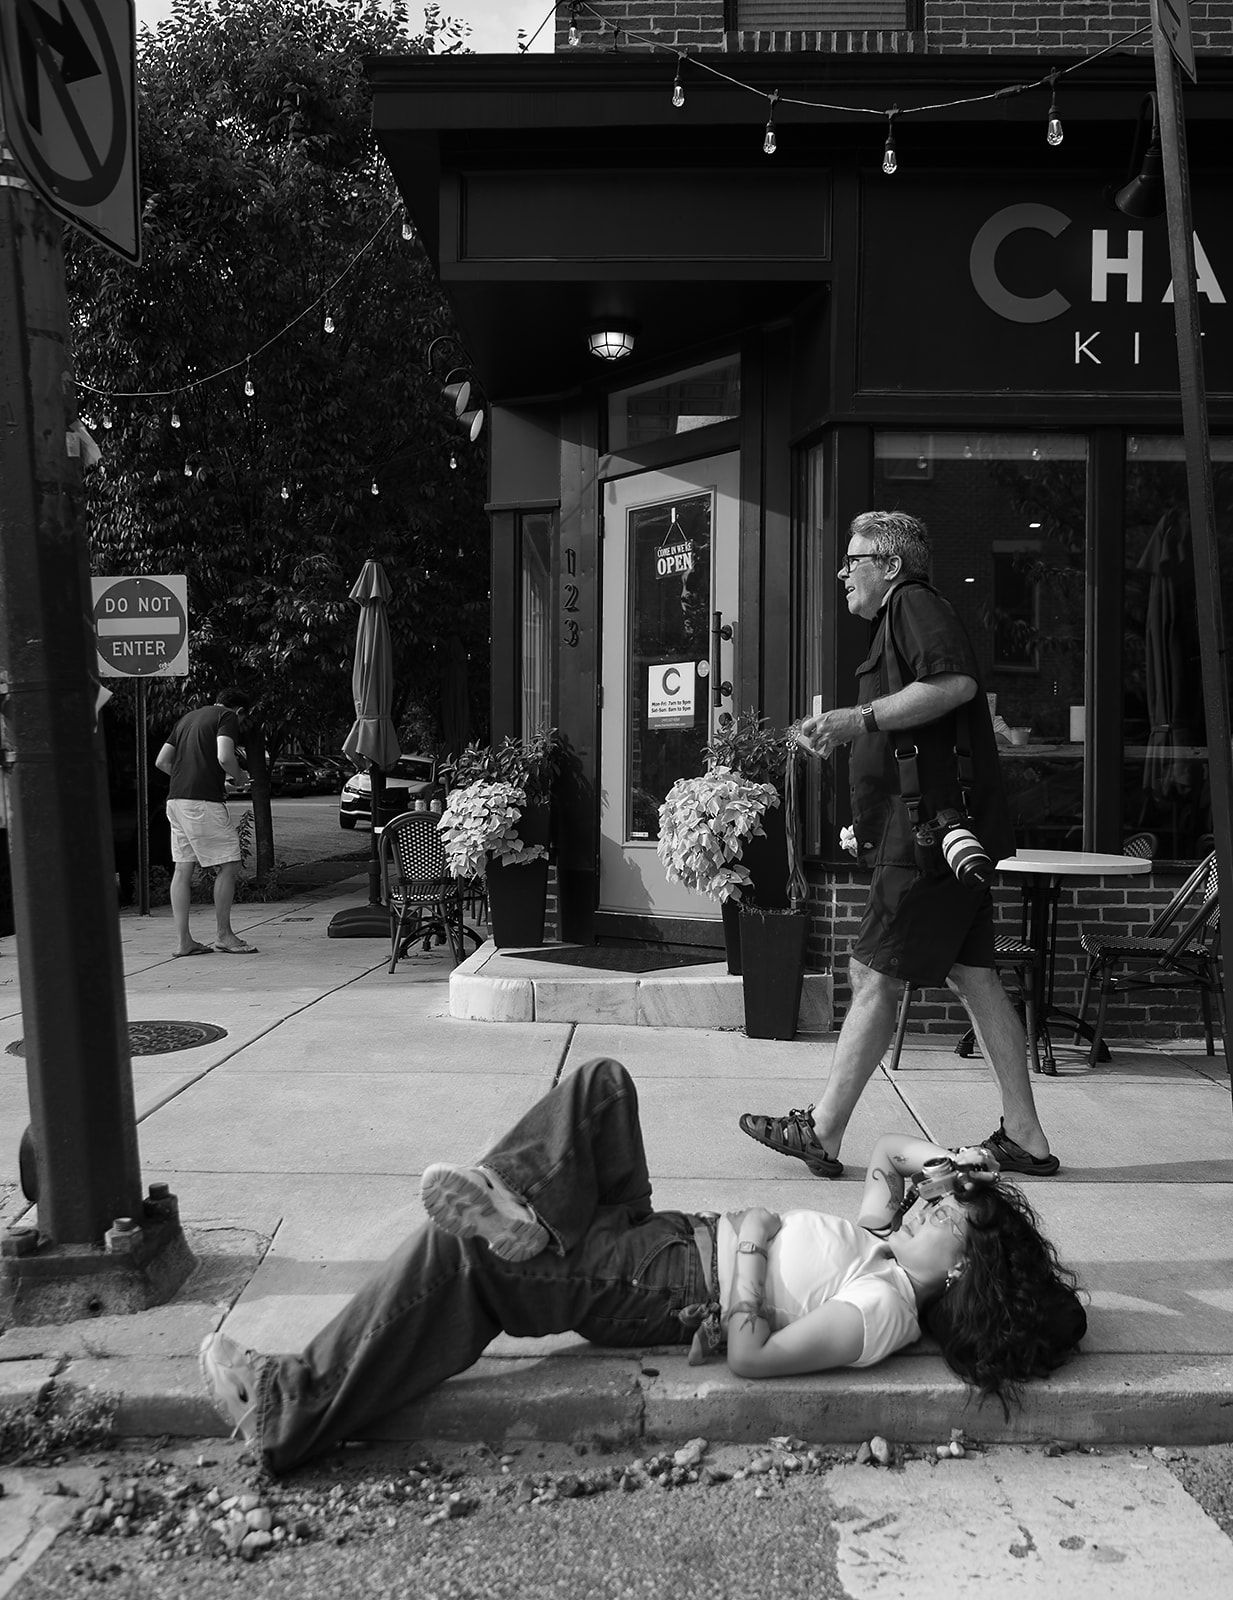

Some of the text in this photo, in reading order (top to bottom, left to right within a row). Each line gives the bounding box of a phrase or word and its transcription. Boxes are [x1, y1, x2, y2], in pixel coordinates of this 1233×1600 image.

[657, 552, 692, 575] OPEN
[105, 597, 171, 613] DO NOT
[112, 641, 166, 656] ENTER
[662, 667, 681, 696] C
